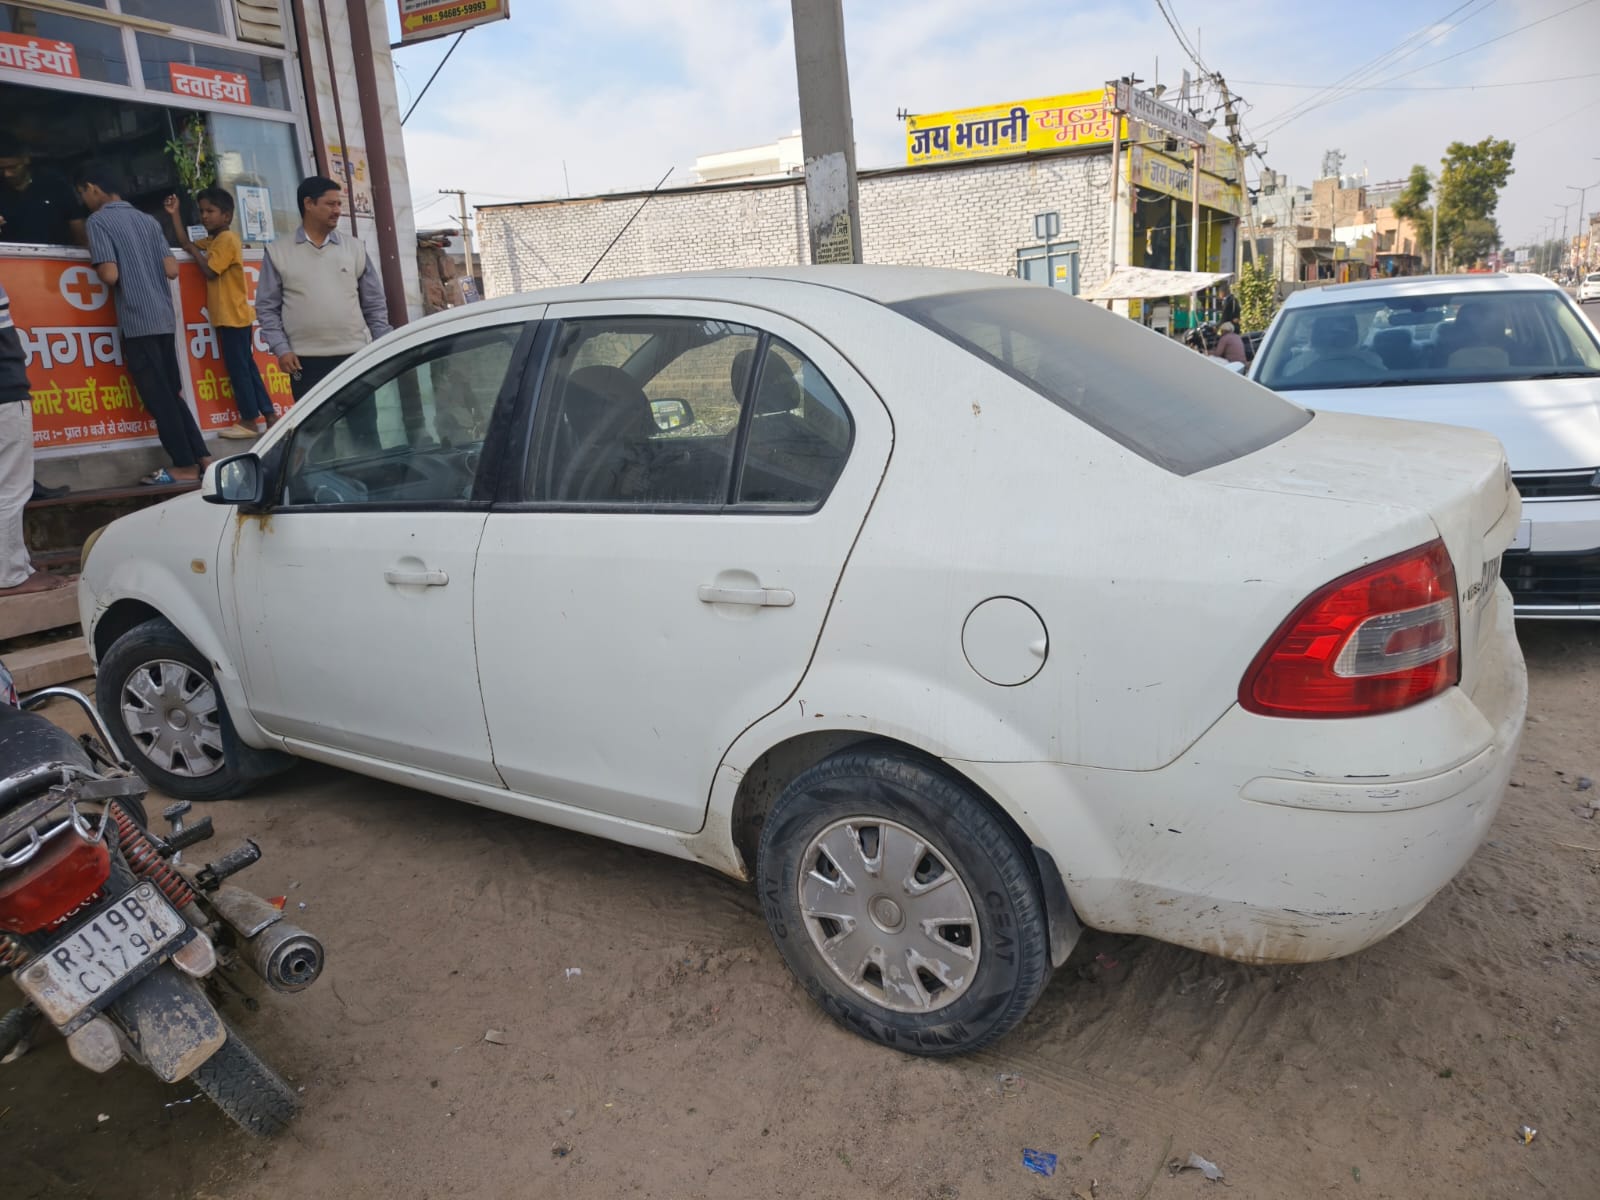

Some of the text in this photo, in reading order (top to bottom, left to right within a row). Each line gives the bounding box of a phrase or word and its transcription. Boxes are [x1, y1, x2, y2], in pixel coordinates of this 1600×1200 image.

[0, 41, 73, 74] वाईयाँ
[173, 72, 247, 103] दवाईयाँ
[910, 126, 951, 155] जय
[956, 107, 1030, 149] भवानी
[16, 326, 124, 369] भगव
[29, 379, 64, 416] मारे
[64, 376, 99, 414] यहाँ
[99, 374, 133, 411] सभी
[196, 368, 219, 401] की
